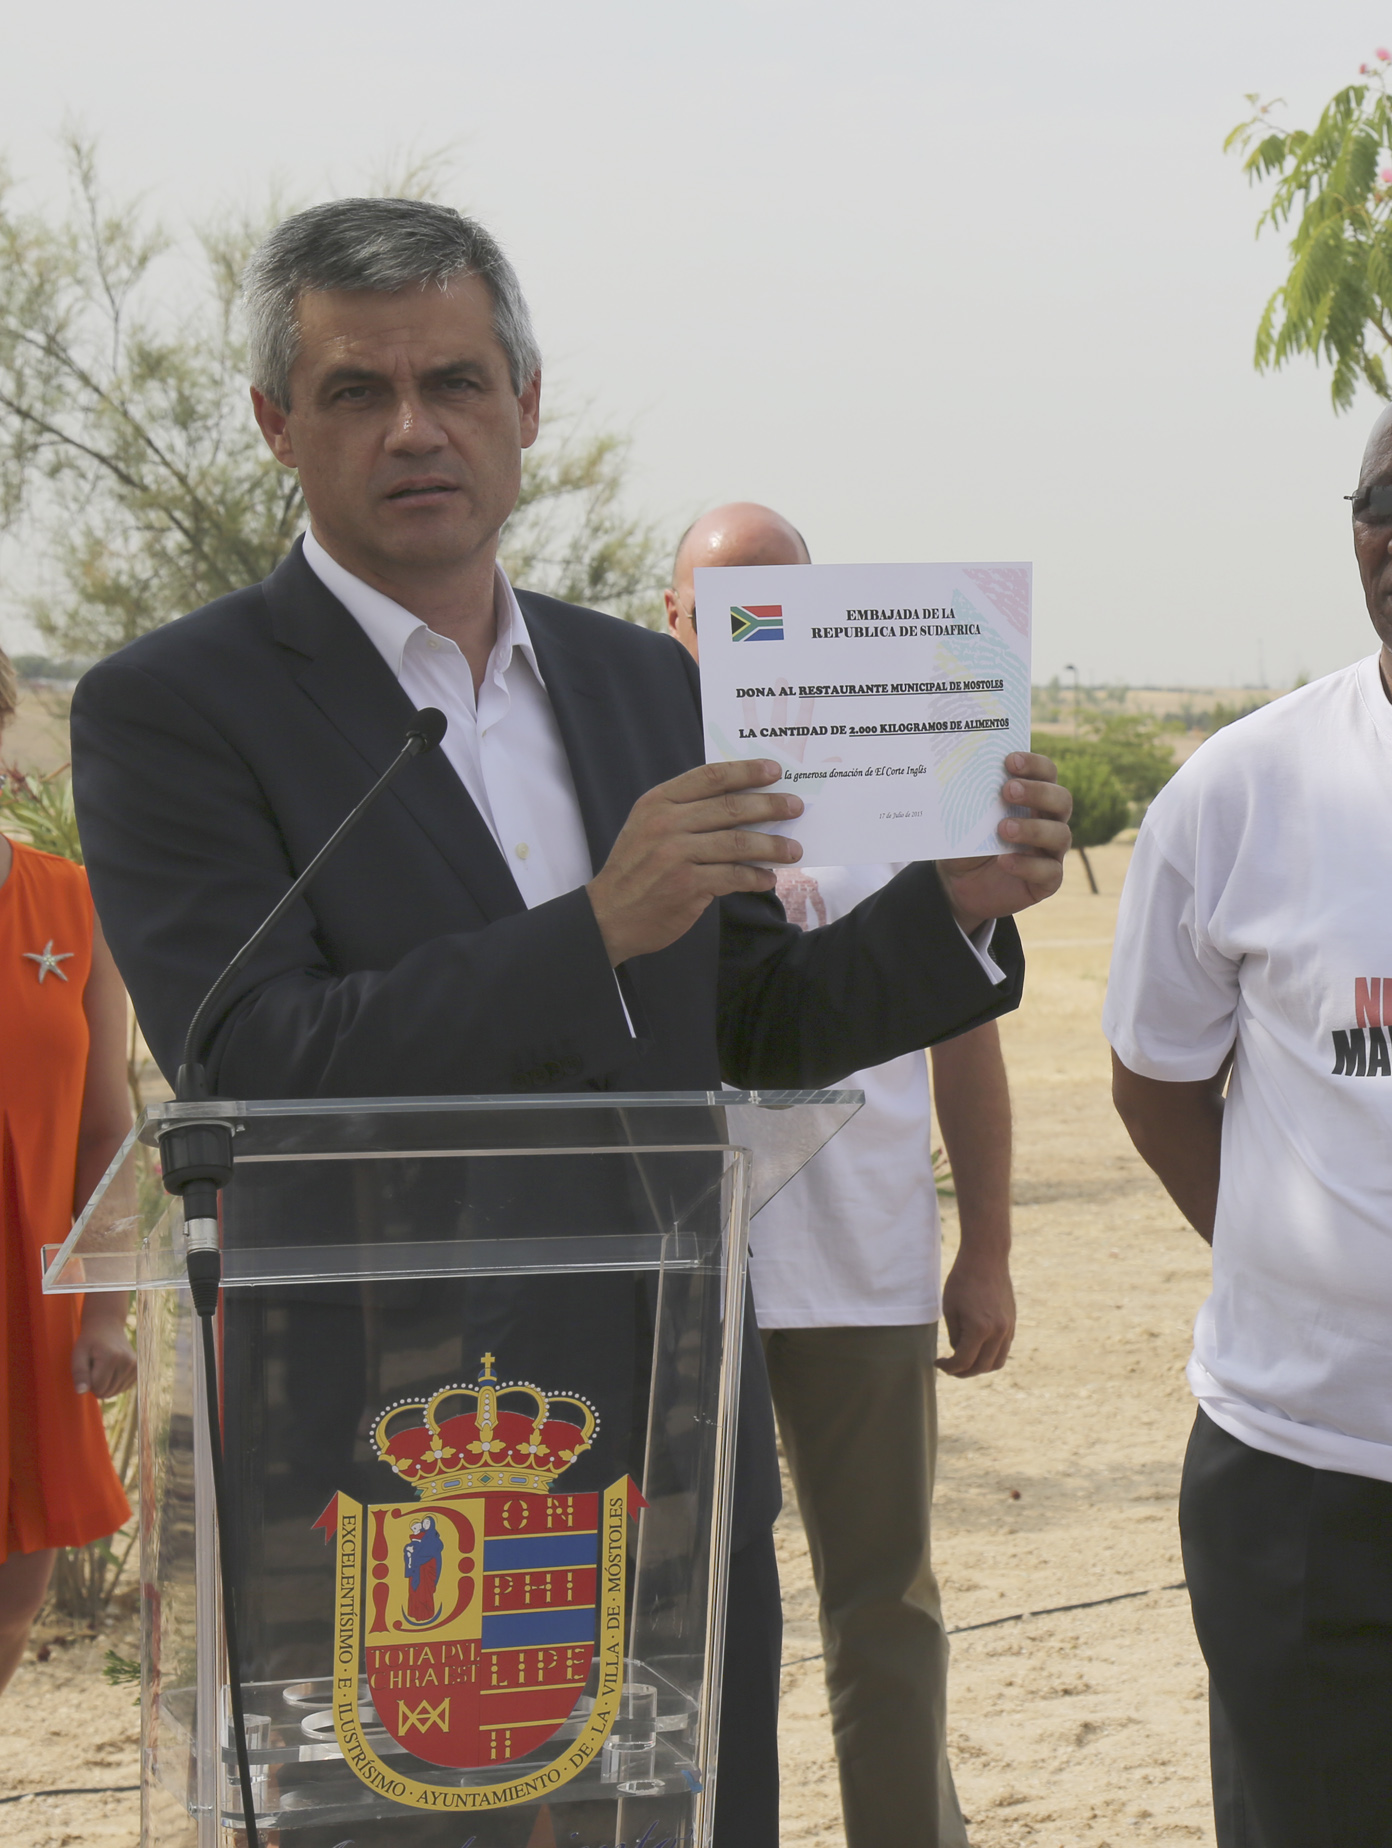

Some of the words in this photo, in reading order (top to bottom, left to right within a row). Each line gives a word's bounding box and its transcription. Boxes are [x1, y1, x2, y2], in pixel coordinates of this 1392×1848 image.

[846, 608, 920, 620] EMBAJADA
[922, 608, 939, 619] DE
[942, 608, 955, 619] LA
[811, 626, 896, 638] REPUBLICA
[899, 625, 918, 637] DE
[920, 624, 981, 636] SUDAFRICA
[736, 687, 776, 698] DONA
[779, 686, 796, 696] AL
[799, 684, 888, 696] RESTAURANTE
[891, 682, 947, 693] MUNICIPAL
[950, 681, 961, 691] DE
[963, 679, 1004, 690] MOSTOLES
[739, 728, 757, 738] LA
[760, 726, 828, 737] CANTIDAD
[830, 725, 847, 735] DE
[849, 726, 878, 735] 2.000
[880, 721, 948, 733] KILOGRAMOS
[949, 720, 963, 730] DE
[964, 718, 1010, 730] ALIMENTOS
[784, 770, 792, 780] la
[793, 771, 827, 782] generosa
[829, 768, 863, 778] donación
[864, 767, 873, 776] de
[875, 766, 886, 776] El
[886, 767, 905, 776] Corte
[907, 764, 927, 777] Inglés
[502, 1496, 574, 1530] ON
[604, 1497, 623, 1593] MÓSTOLES
[338, 1514, 358, 1664] EXCELENTÍSIMO
[493, 1571, 574, 1607] PHI
[606, 1605, 620, 1630] DE
[371, 1646, 435, 1669] TOTA
[490, 1648, 585, 1686] LIPE
[602, 1642, 620, 1697] VILLA
[338, 1677, 352, 1689] E
[591, 1710, 611, 1735] LA
[338, 1702, 407, 1797] ILUSTRÍSIMO
[569, 1743, 594, 1769] DE
[416, 1769, 561, 1808] AYUNTAMIENTO
